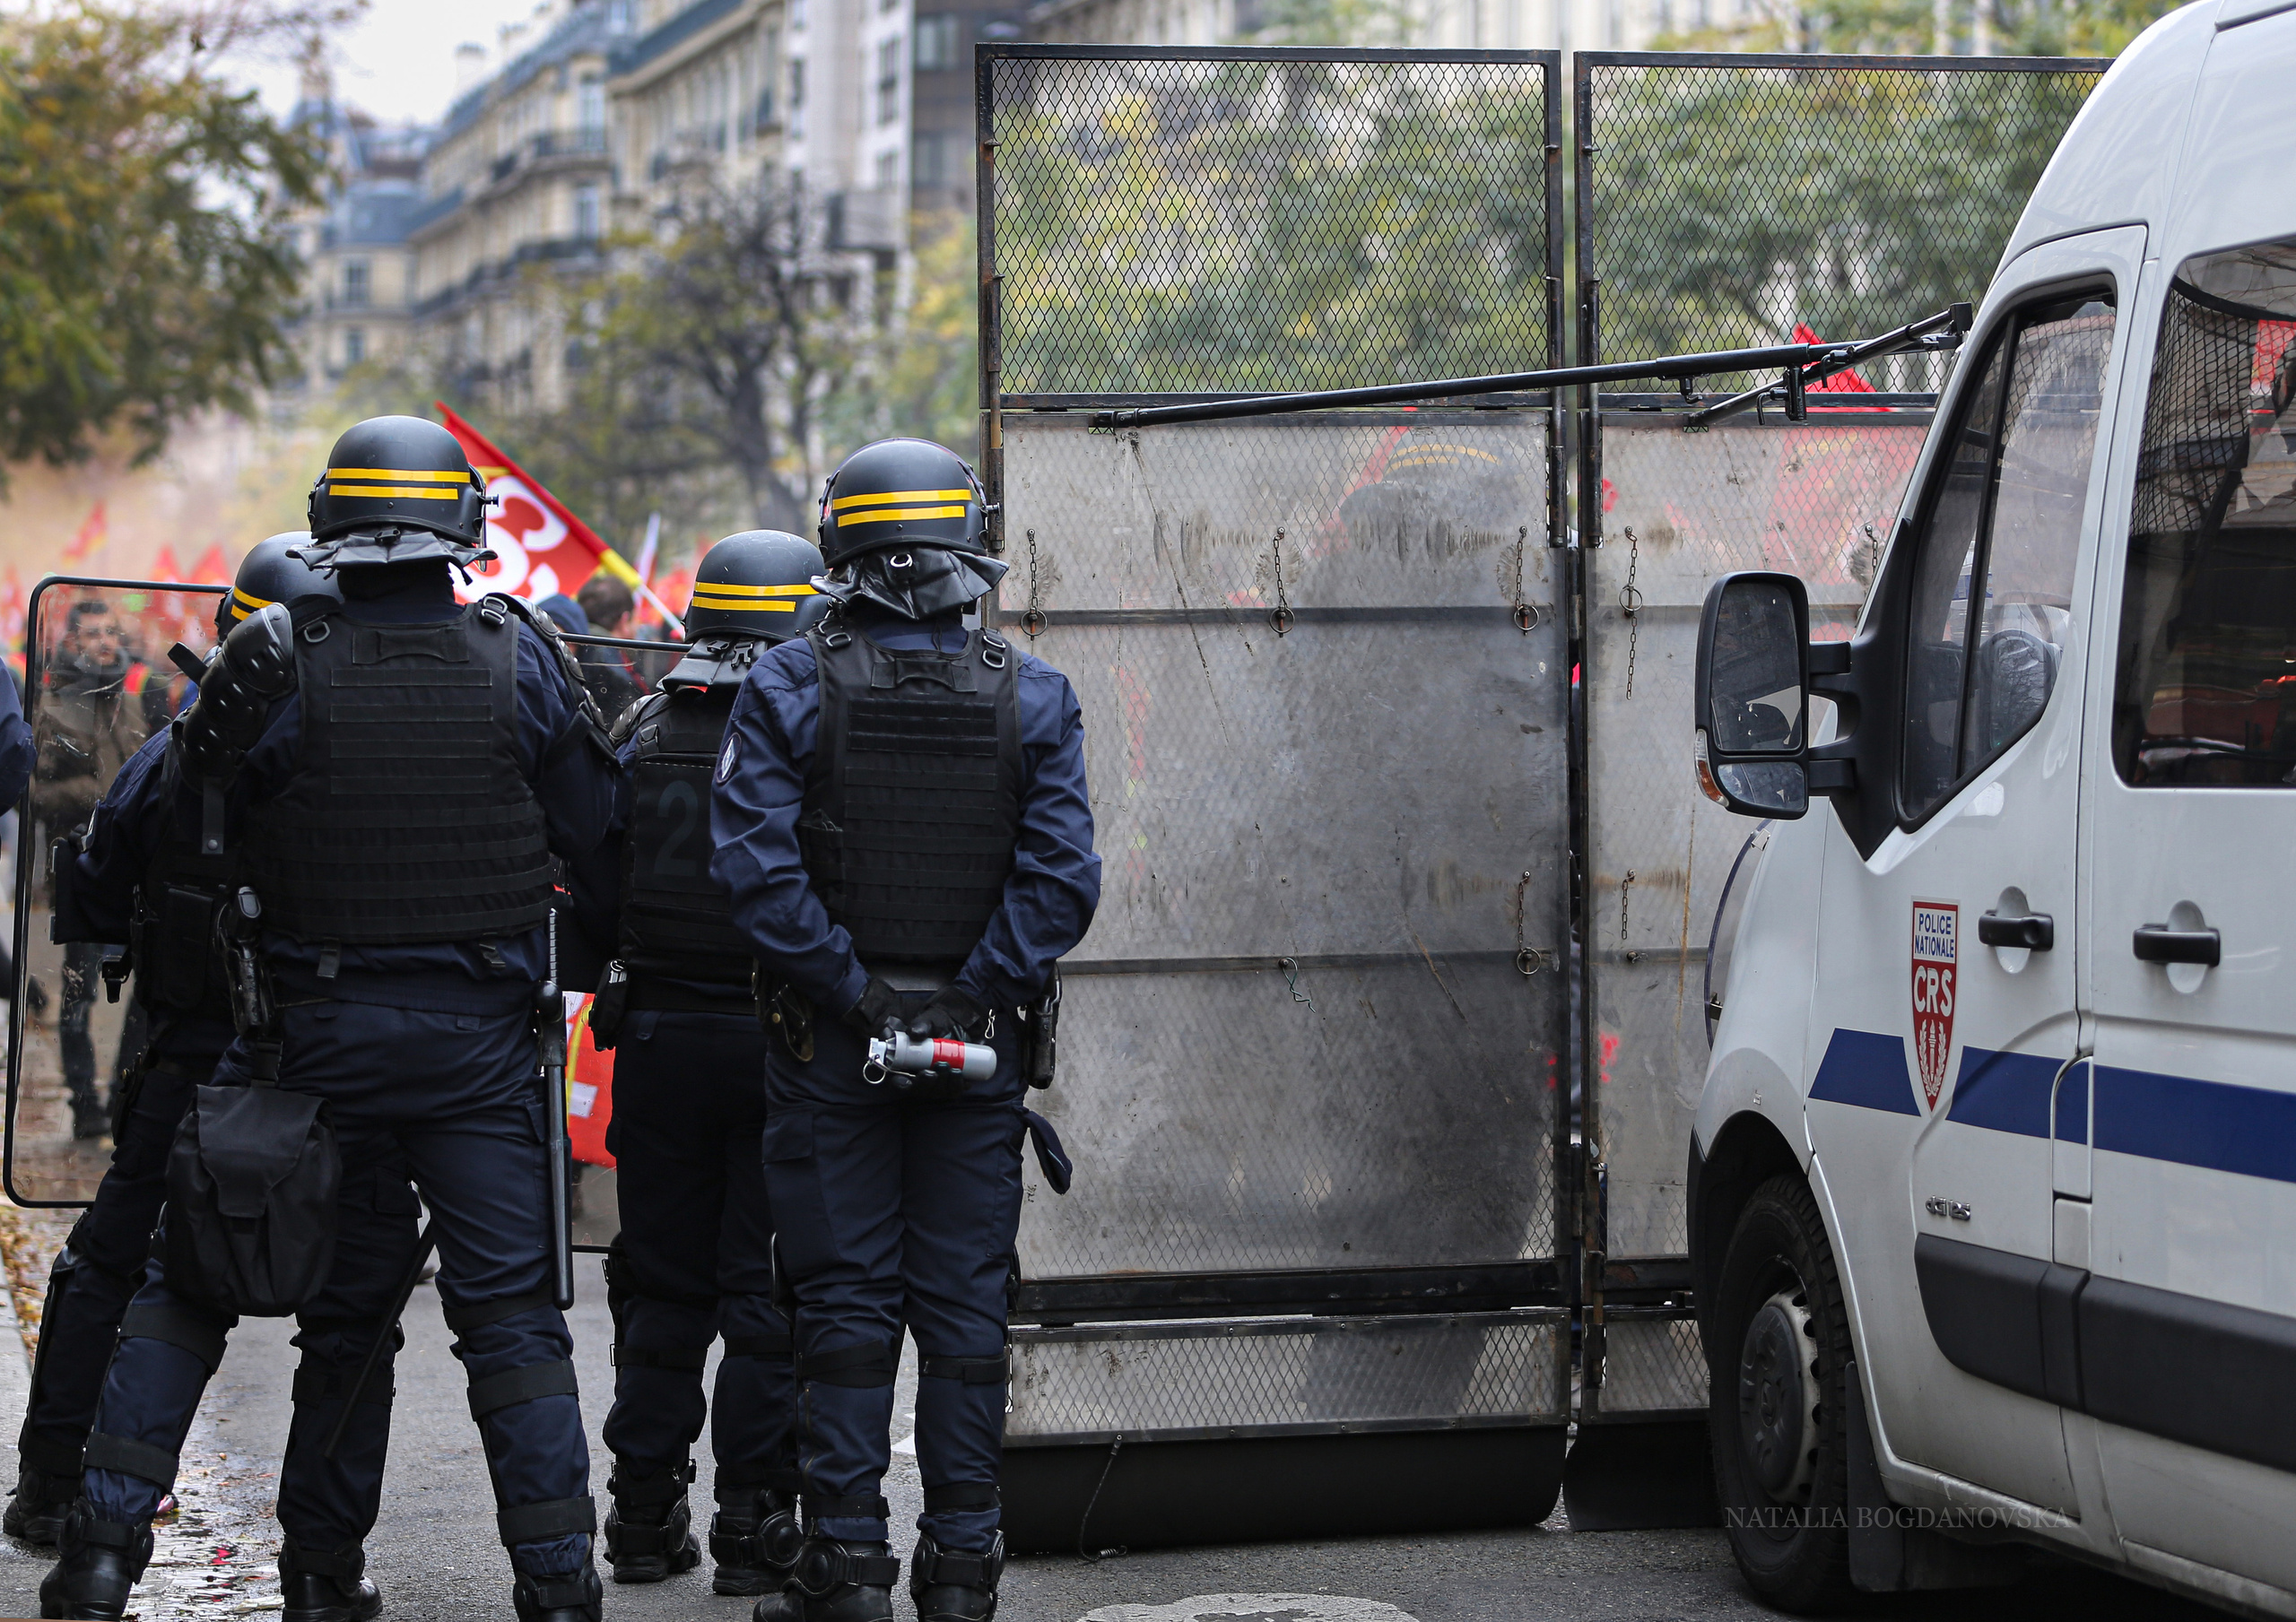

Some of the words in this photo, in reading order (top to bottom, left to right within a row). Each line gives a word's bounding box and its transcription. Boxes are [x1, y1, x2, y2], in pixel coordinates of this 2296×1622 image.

[654, 780, 698, 876] 2
[1918, 913, 1952, 935] POLICE
[1914, 934, 1954, 958] NATIONALE
[1913, 965, 1952, 1018] CRS
